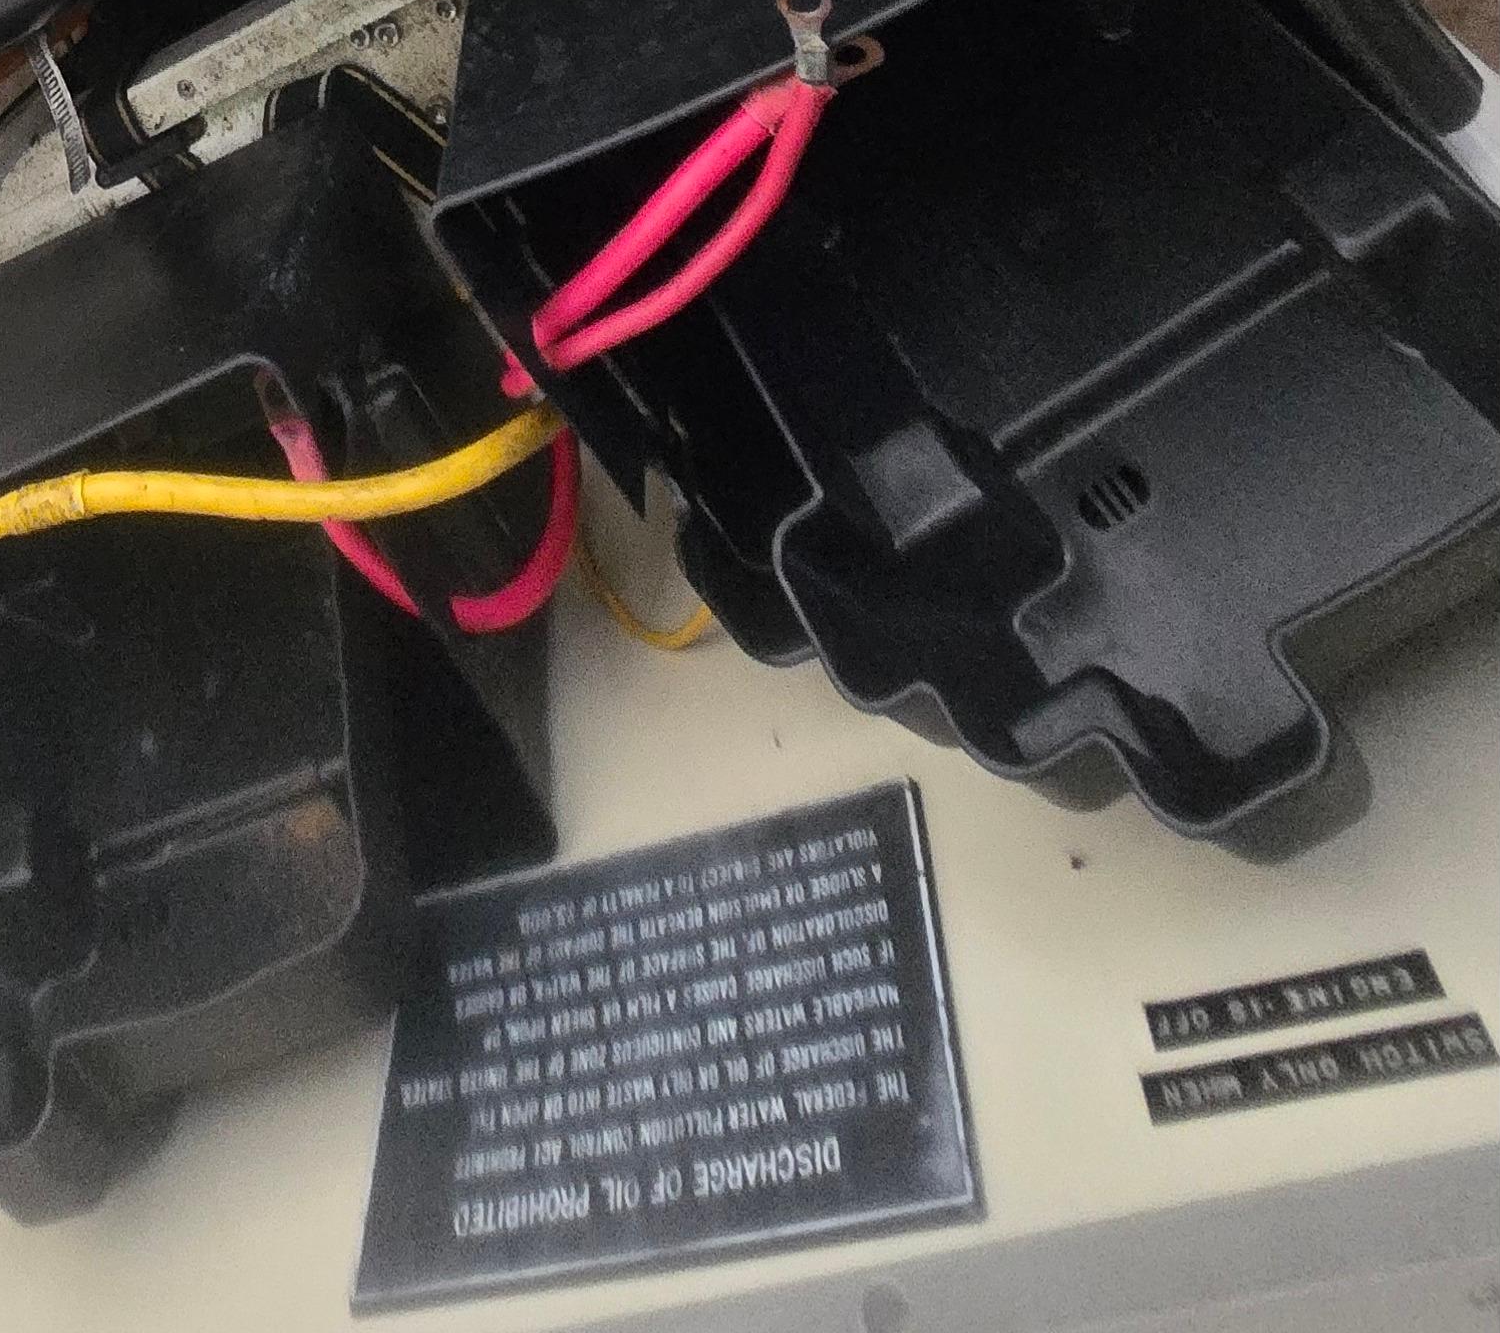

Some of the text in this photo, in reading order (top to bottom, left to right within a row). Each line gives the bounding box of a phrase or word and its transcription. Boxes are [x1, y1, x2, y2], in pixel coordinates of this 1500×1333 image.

[767, 847, 793, 870] ARE
[799, 828, 877, 862] VIOLATORS
[663, 877, 674, 897] A
[810, 866, 866, 899] SLUDGE
[870, 862, 882, 884] A
[707, 886, 780, 922] EMULSION
[784, 882, 805, 905] OR
[610, 923, 634, 948] THE
[639, 906, 703, 938] BENEATH
[771, 899, 888, 945] DISCOLORATION
[642, 943, 704, 976] SURFACE
[710, 936, 736, 961] THE
[831, 943, 871, 972] SUCH
[878, 938, 895, 964] IF
[586, 965, 611, 990] THE
[618, 958, 635, 983] OF
[746, 956, 825, 991] DISCHARGE
[664, 988, 676, 1011] A
[683, 975, 737, 1004] CAUSES
[813, 984, 899, 1021] NAVIGABLE
[1282, 967, 1415, 1014] ENGINE
[602, 1000, 621, 1025] OR
[626, 993, 661, 1018] FILM
[744, 1003, 806, 1036] WATERS
[706, 1017, 737, 1044] AND
[1157, 1006, 1210, 1037] OFF
[612, 1026, 701, 1063] CONTIGUOUS
[870, 1024, 904, 1051] THE
[547, 1050, 564, 1078] OF
[755, 1050, 775, 1078] OF
[782, 1034, 865, 1072] DISCHARGE
[697, 1063, 719, 1090] OR
[724, 1056, 749, 1082] OIL
[1162, 1027, 1487, 1109] SWITCH ONLY WHEN
[567, 1088, 600, 1115] INTO
[606, 1076, 655, 1107] WASTE
[794, 1080, 866, 1114] FEDERAL
[875, 1071, 909, 1103] THE
[543, 1093, 563, 1121] OR
[727, 1095, 787, 1129] WATER
[639, 1109, 723, 1145] POLLUTION
[453, 1137, 840, 1235] DISCHARGE OF OIL PROHIBITED
